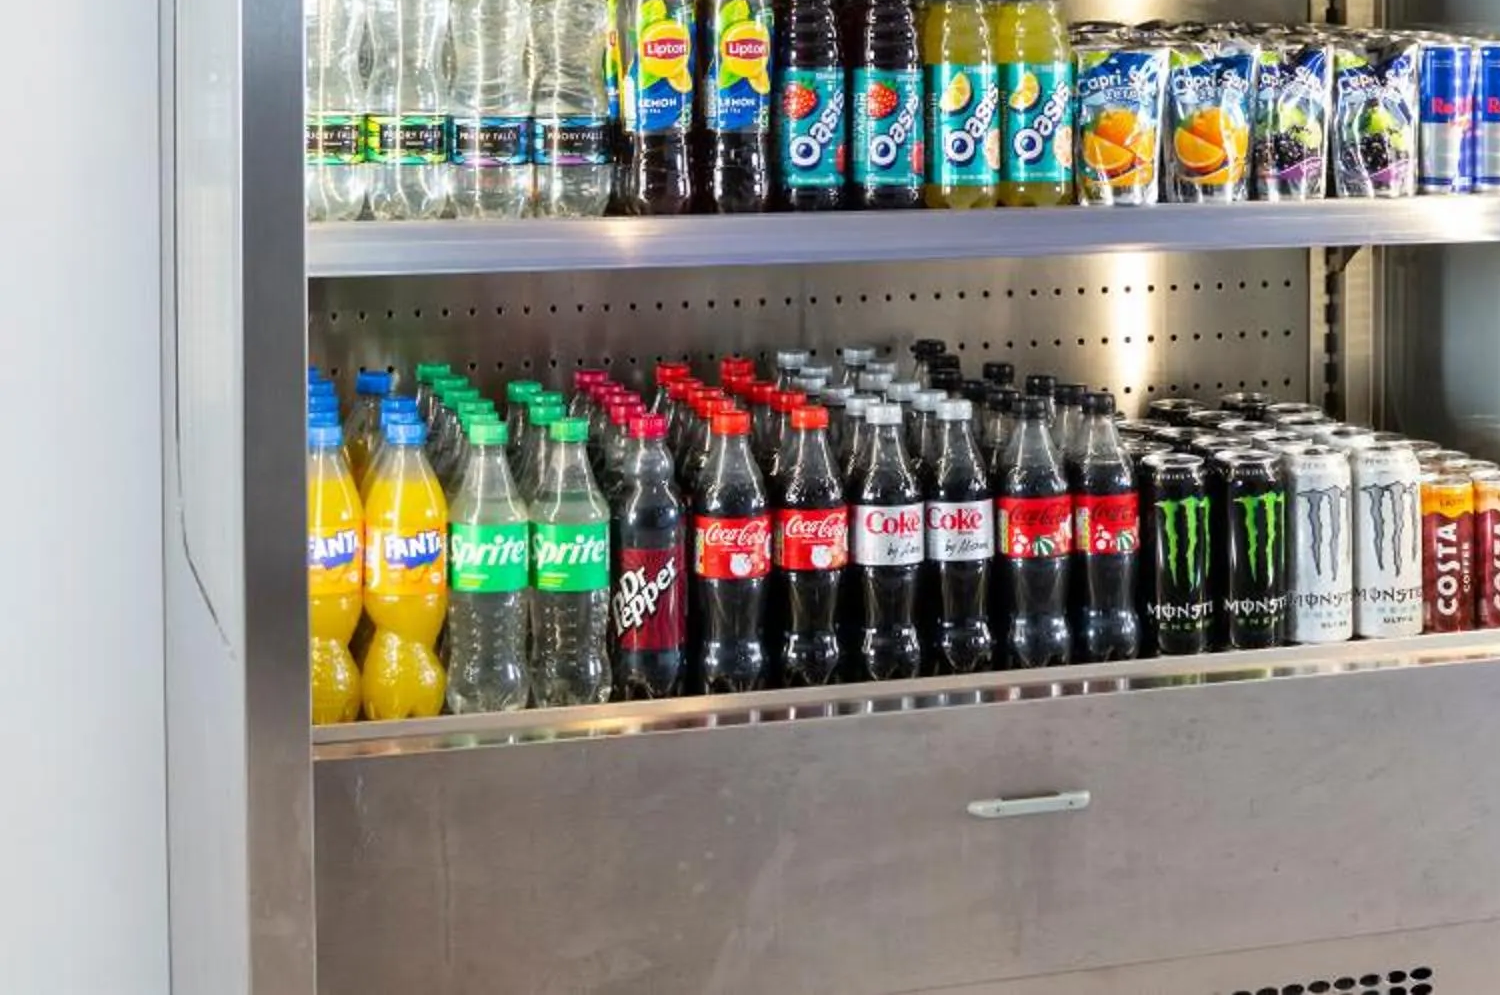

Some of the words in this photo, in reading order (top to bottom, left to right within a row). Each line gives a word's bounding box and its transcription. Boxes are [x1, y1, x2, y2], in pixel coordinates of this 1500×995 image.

[647, 43, 687, 58] Lipton
[728, 43, 766, 58] Lipton
[638, 98, 677, 107] LEMON
[719, 98, 756, 107] LEMON
[786, 512, 847, 538] Coca-Cola
[866, 510, 921, 536] Coke
[925, 506, 983, 531] Coke
[308, 530, 357, 561] FANT
[706, 519, 768, 546] Coca-Cola
[452, 533, 525, 571] Sprite
[533, 533, 605, 571] Sprite
[1436, 522, 1460, 616] COSTA
[612, 557, 677, 637] Pepper
[620, 566, 647, 602] Dr
[1147, 599, 1213, 620] MONST
[1224, 596, 1286, 615] MONST
